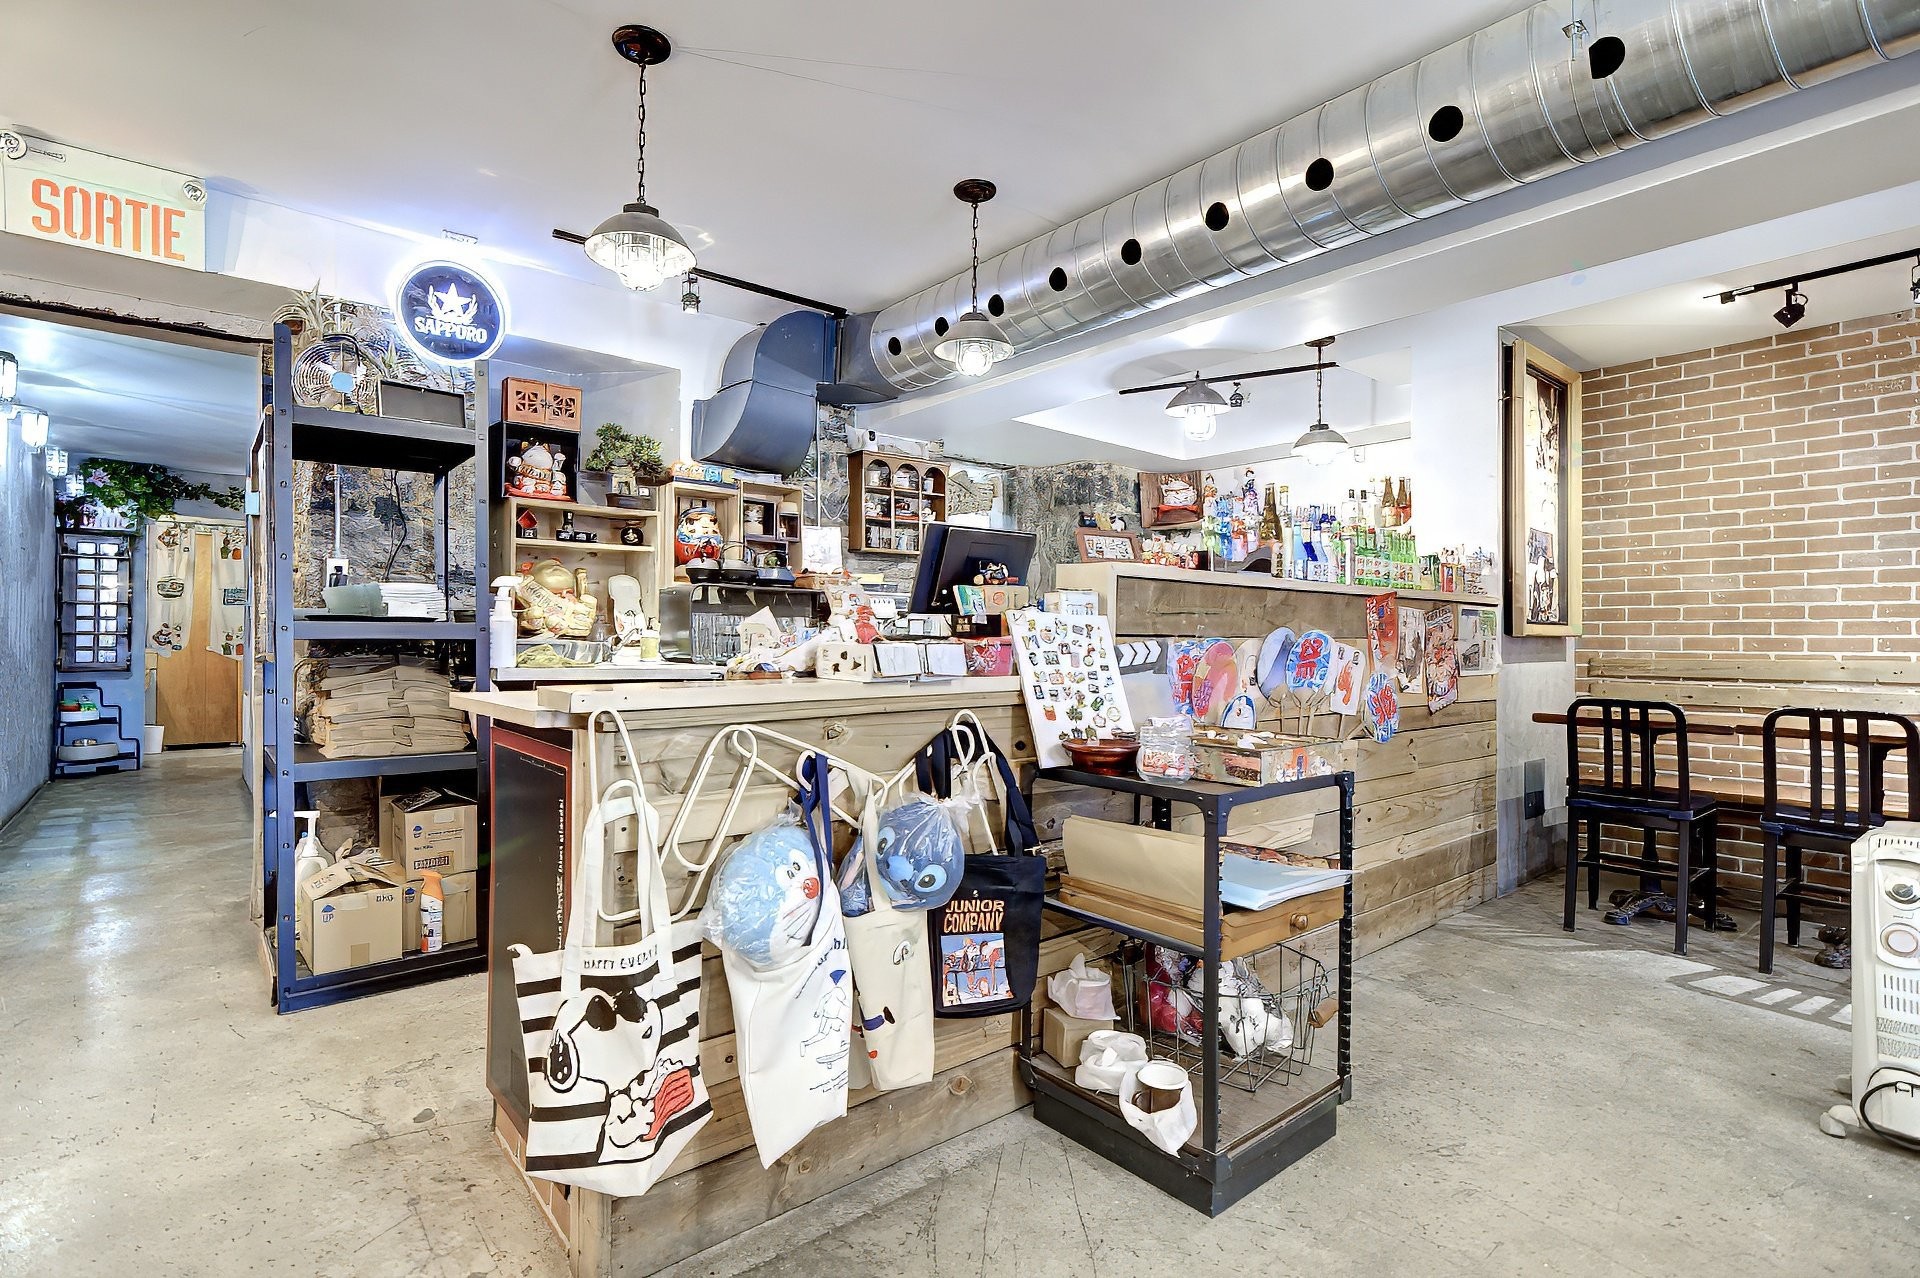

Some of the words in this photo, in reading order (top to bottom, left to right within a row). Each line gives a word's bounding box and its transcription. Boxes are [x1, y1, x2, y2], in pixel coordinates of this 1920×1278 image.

[32, 178, 186, 262] SORTIE
[414, 316, 488, 344] SAPPORO
[945, 899, 1005, 913] JUNIOR
[943, 911, 1005, 933] COMPANY
